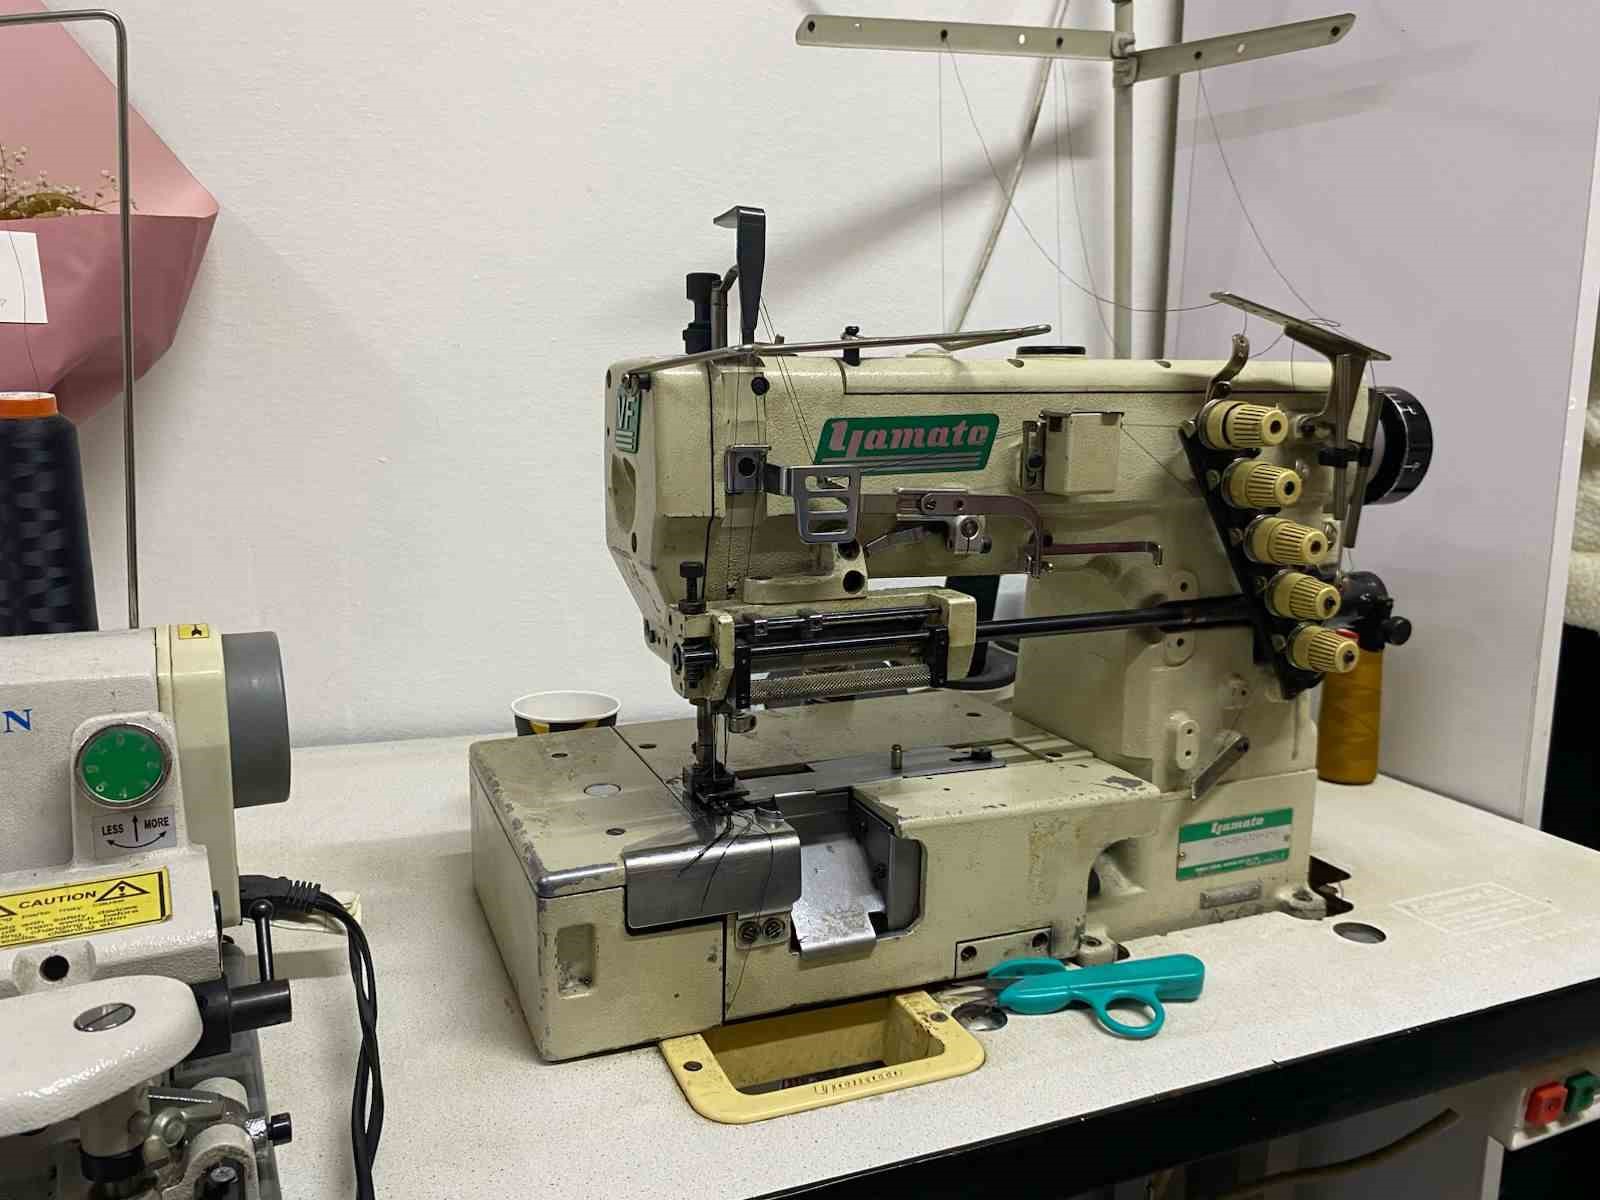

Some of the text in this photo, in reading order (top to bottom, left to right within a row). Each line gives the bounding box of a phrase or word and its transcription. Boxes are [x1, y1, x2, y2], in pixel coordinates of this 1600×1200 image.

[101, 816, 170, 836] LESS MORE
[18, 891, 97, 909] CAUTION
